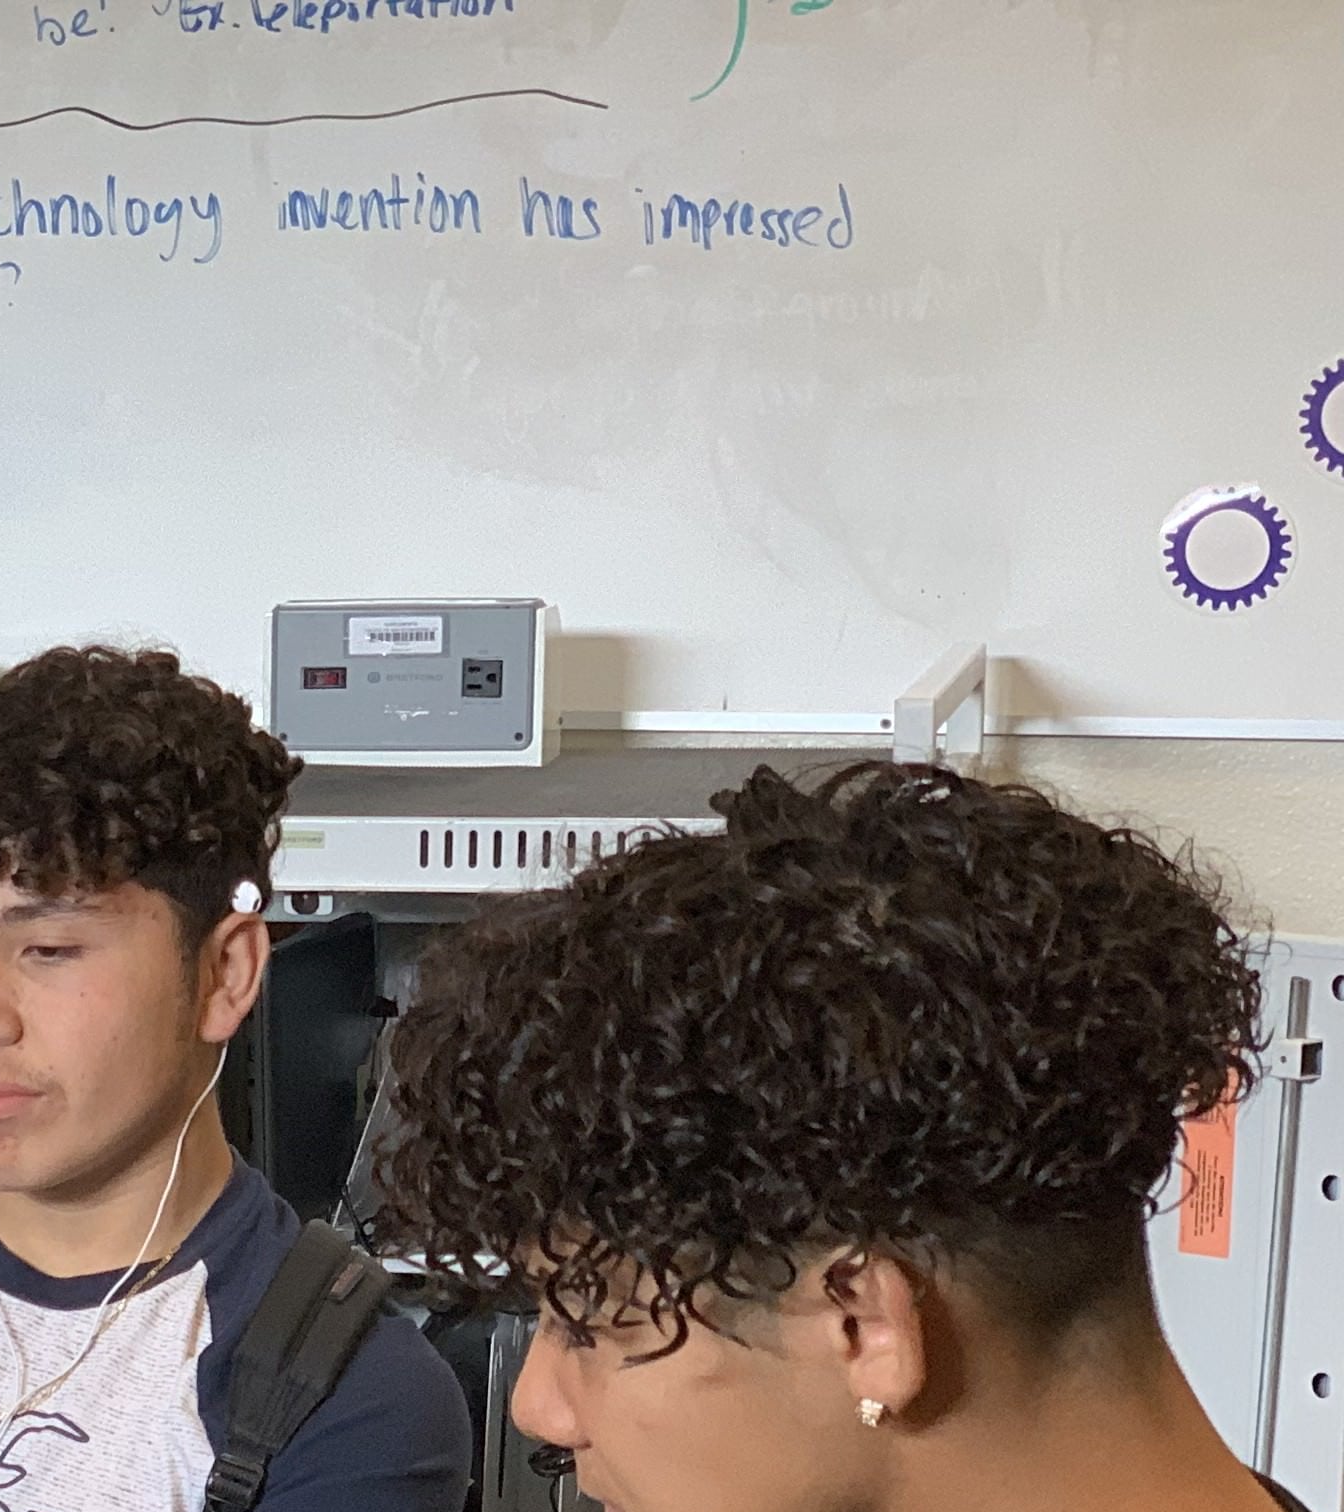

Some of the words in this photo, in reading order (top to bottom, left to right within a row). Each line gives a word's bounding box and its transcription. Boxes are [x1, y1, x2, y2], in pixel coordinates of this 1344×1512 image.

[272, 172, 482, 234] invention
[519, 175, 602, 241] has
[634, 183, 854, 251] impressed
